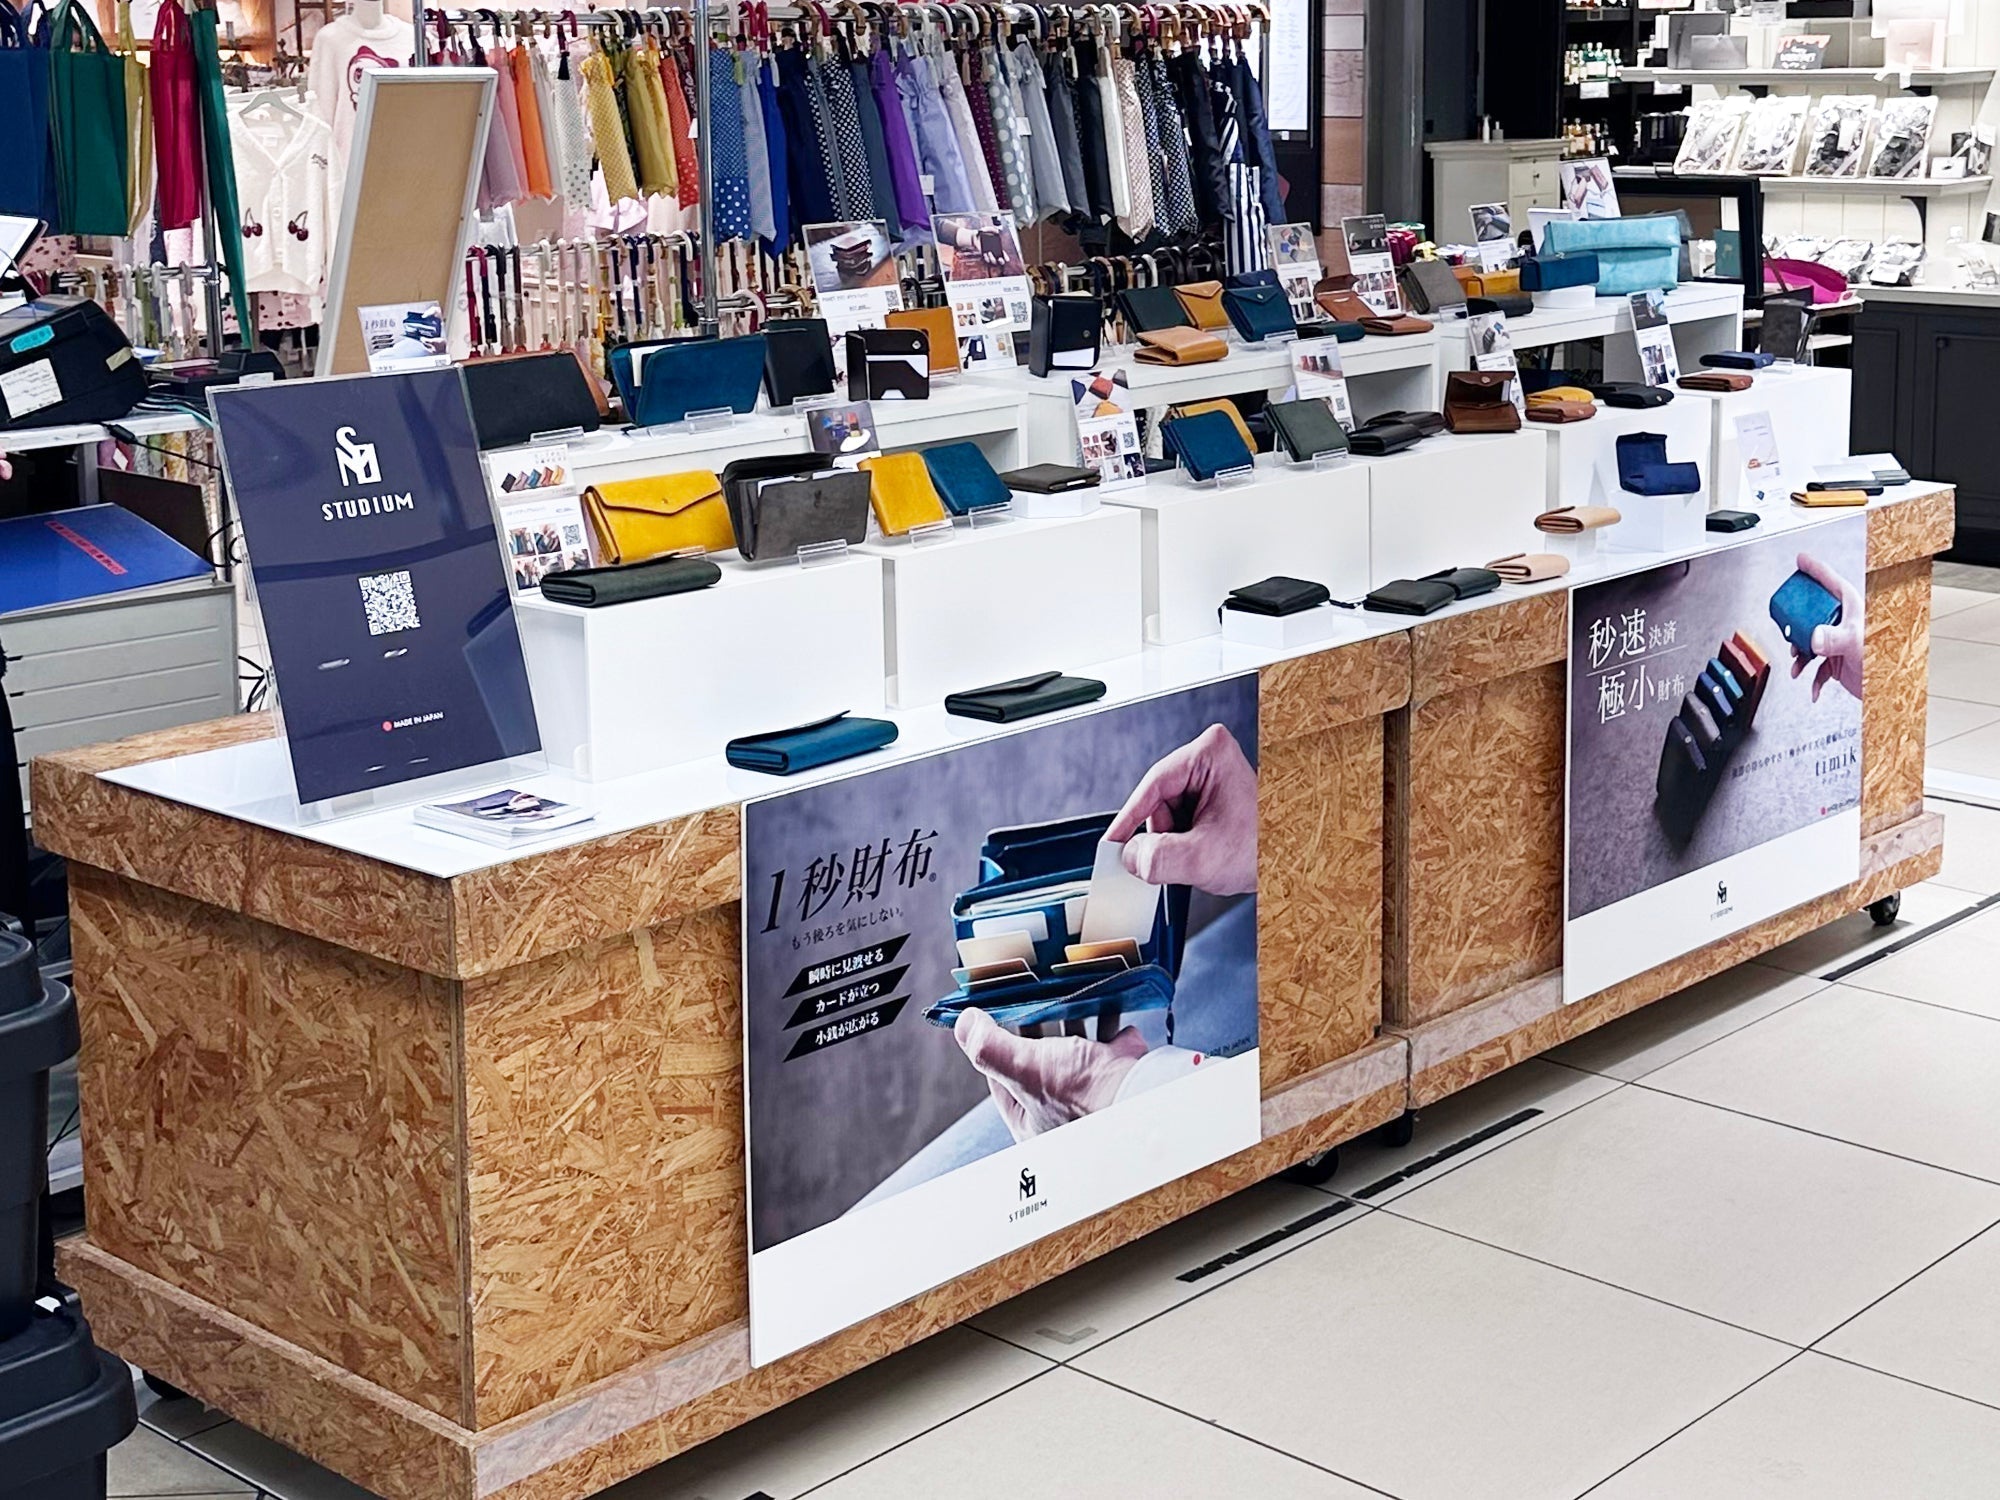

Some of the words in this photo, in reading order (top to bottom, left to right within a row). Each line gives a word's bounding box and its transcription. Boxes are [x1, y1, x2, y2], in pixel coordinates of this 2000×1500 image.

[321, 492, 415, 521] STUDIUM
[1587, 608, 1677, 669] 秒速決済
[1597, 664, 1685, 724] 極小財布
[815, 982, 880, 1014] カードが立つ
[815, 1011, 880, 1045] 小銭が広がる
[1008, 1198, 1048, 1223] STUDIUM
